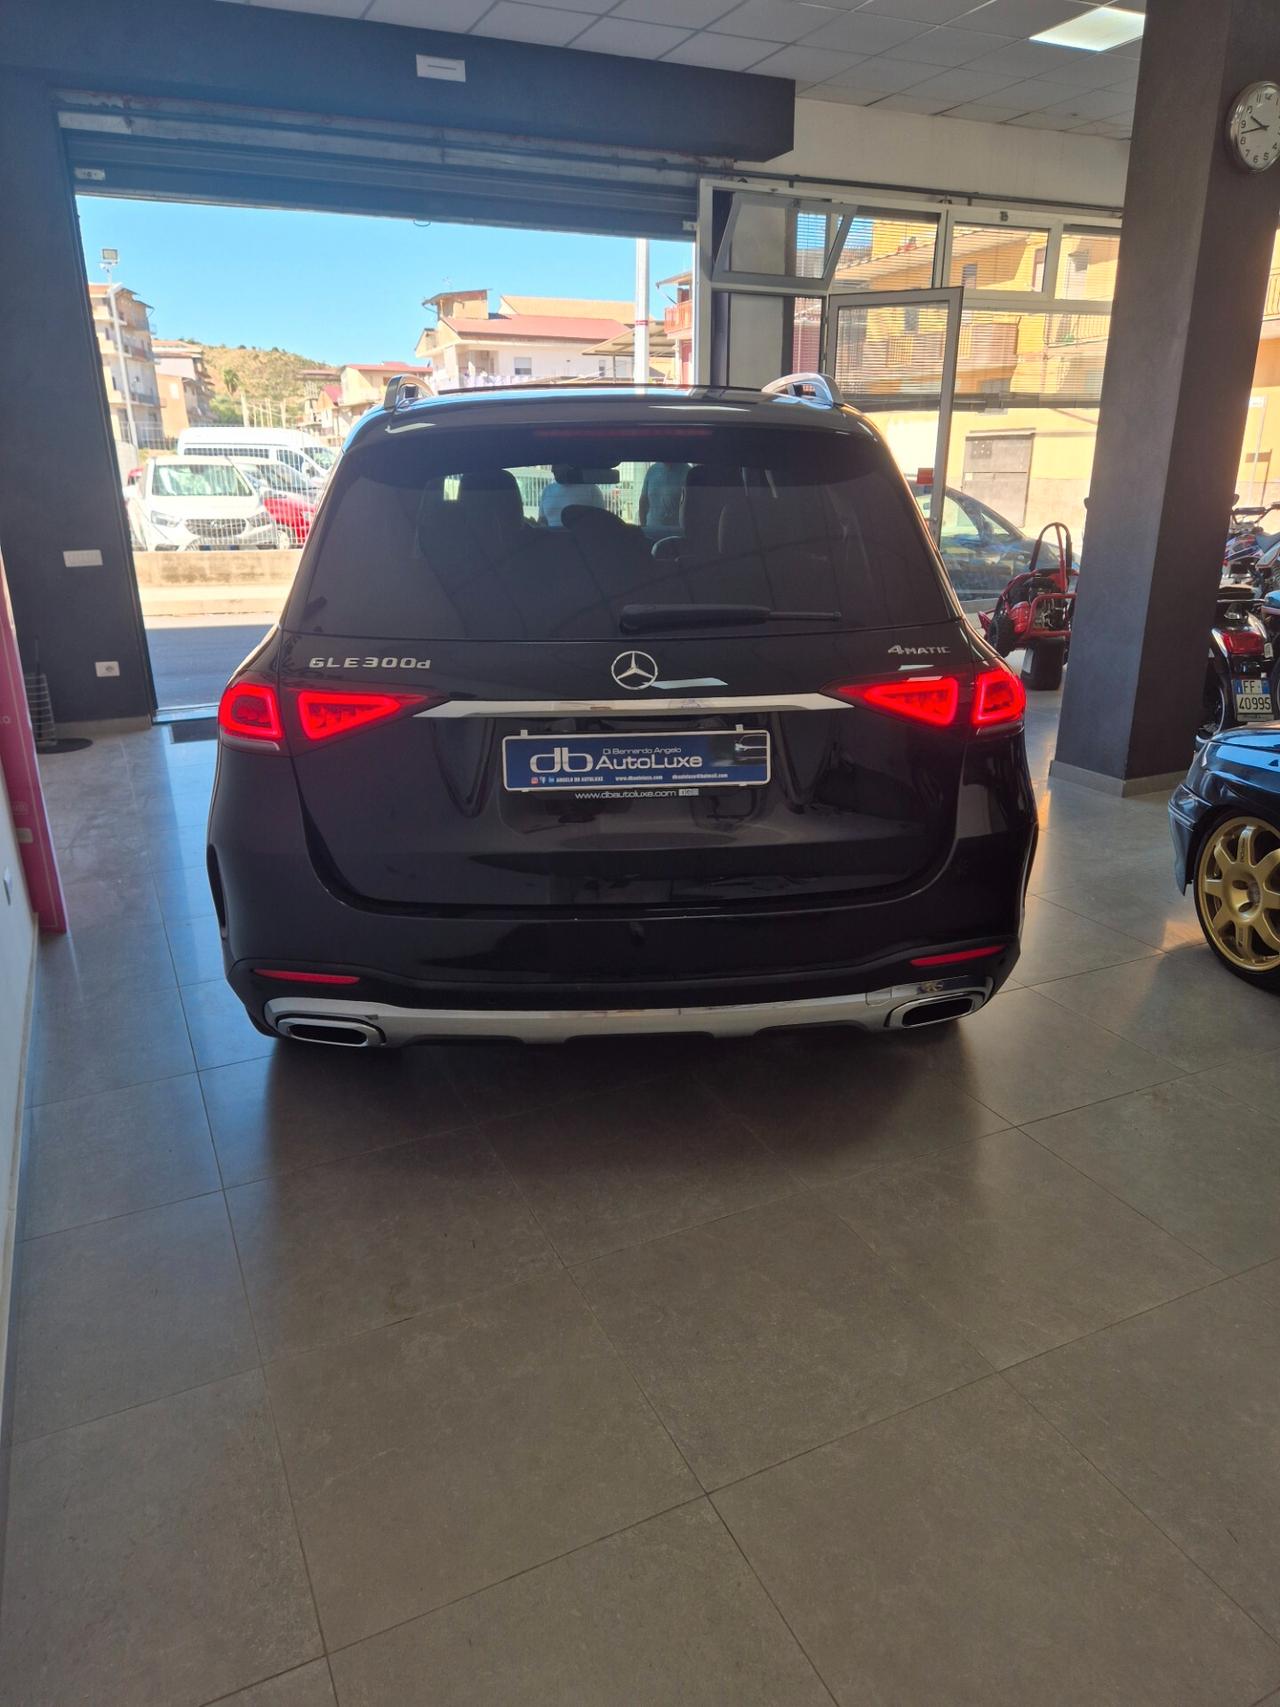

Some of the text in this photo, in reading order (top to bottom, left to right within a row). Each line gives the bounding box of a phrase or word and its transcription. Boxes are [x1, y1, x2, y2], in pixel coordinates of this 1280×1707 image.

[1241, 120, 1246, 128] 9
[887, 644, 951, 655] 4MATIC
[1239, 696, 1271, 711] 40995
[653, 746, 682, 755] Angelo
[529, 747, 593, 774] db
[595, 754, 703, 770] AutoLuxe
[575, 789, 677, 799] www.dbautoluxe.com
